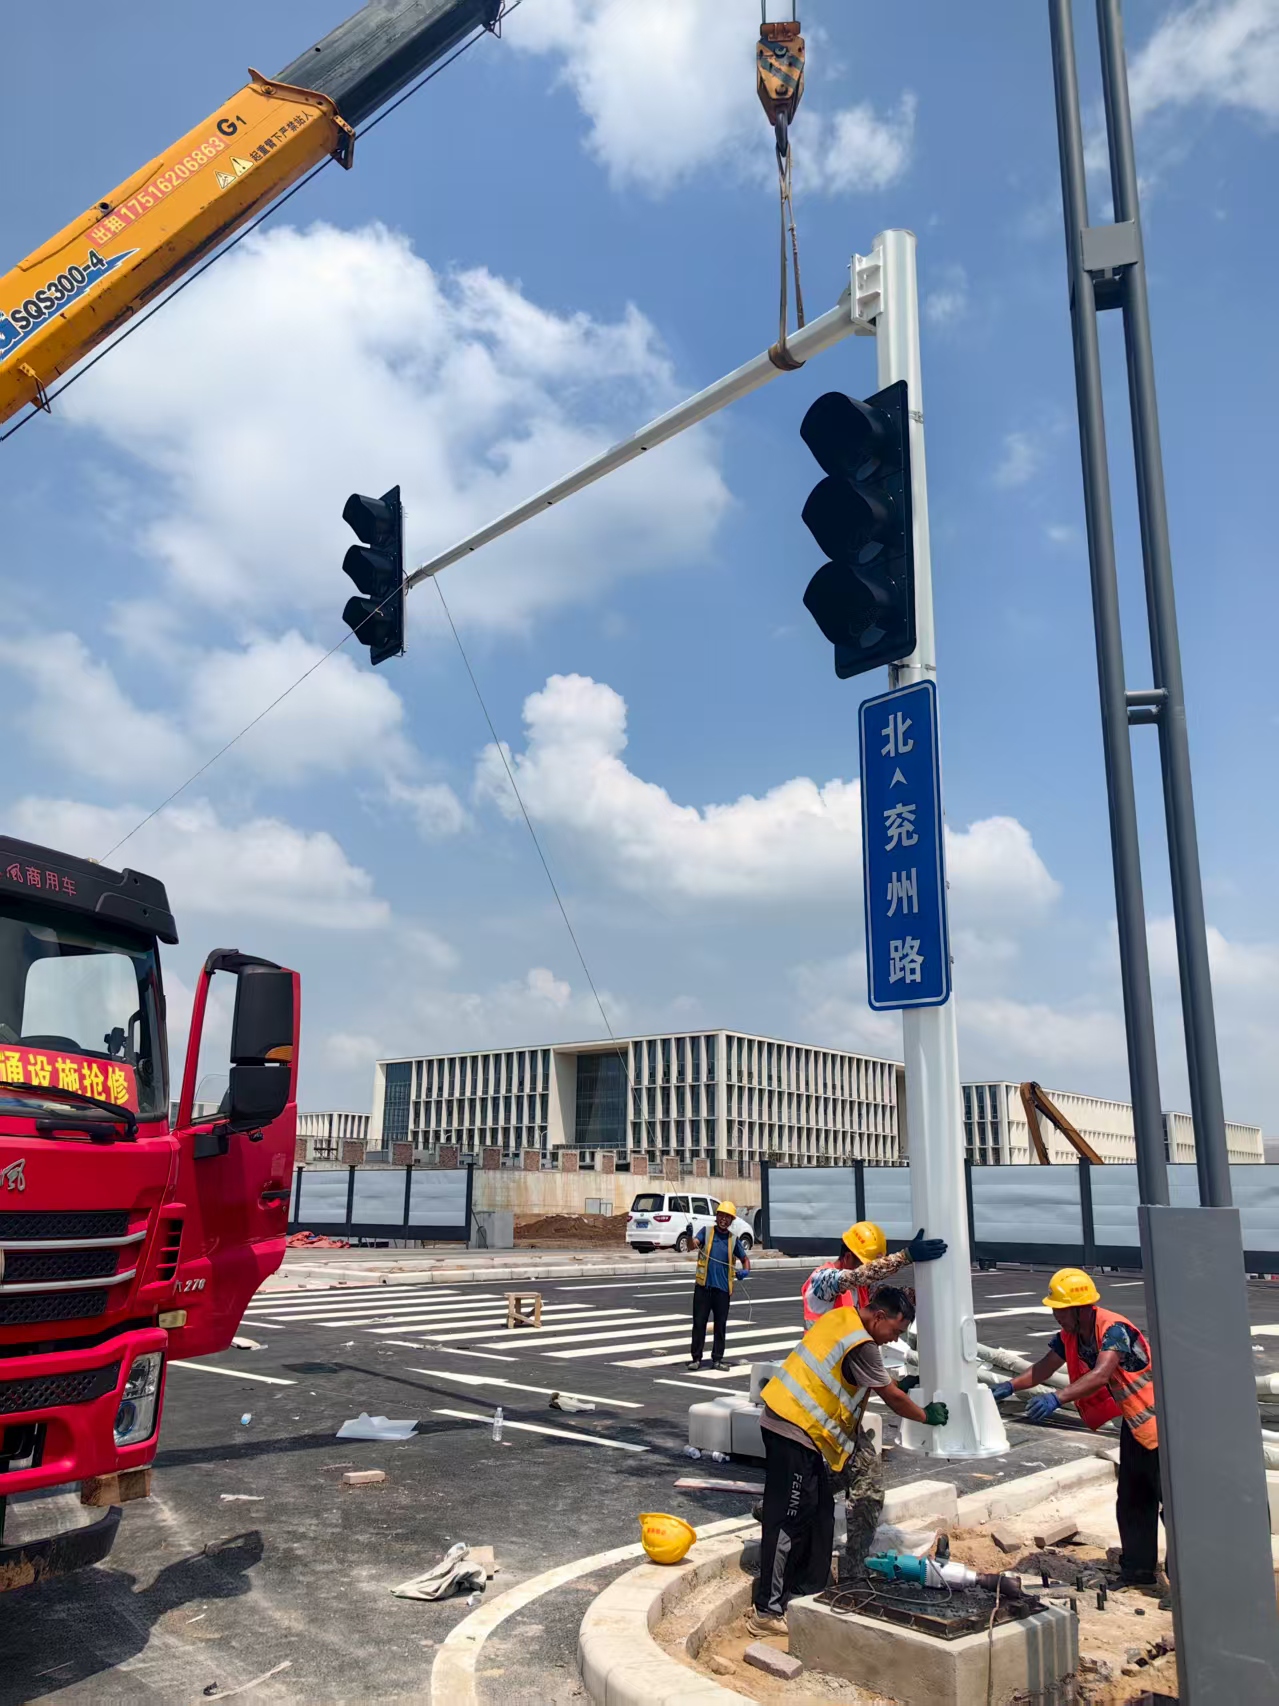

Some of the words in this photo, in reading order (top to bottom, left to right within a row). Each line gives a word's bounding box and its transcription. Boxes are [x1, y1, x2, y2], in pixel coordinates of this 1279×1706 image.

[249, 110, 314, 163] 起重臂下严禁站人
[91, 215, 127, 245] 出租
[120, 136, 226, 220] 17516206863
[10, 248, 107, 331] SQS300-4
[880, 711, 914, 758] 北
[883, 802, 925, 984] 兖州路
[0, 1050, 130, 1106] 通设施抢修
